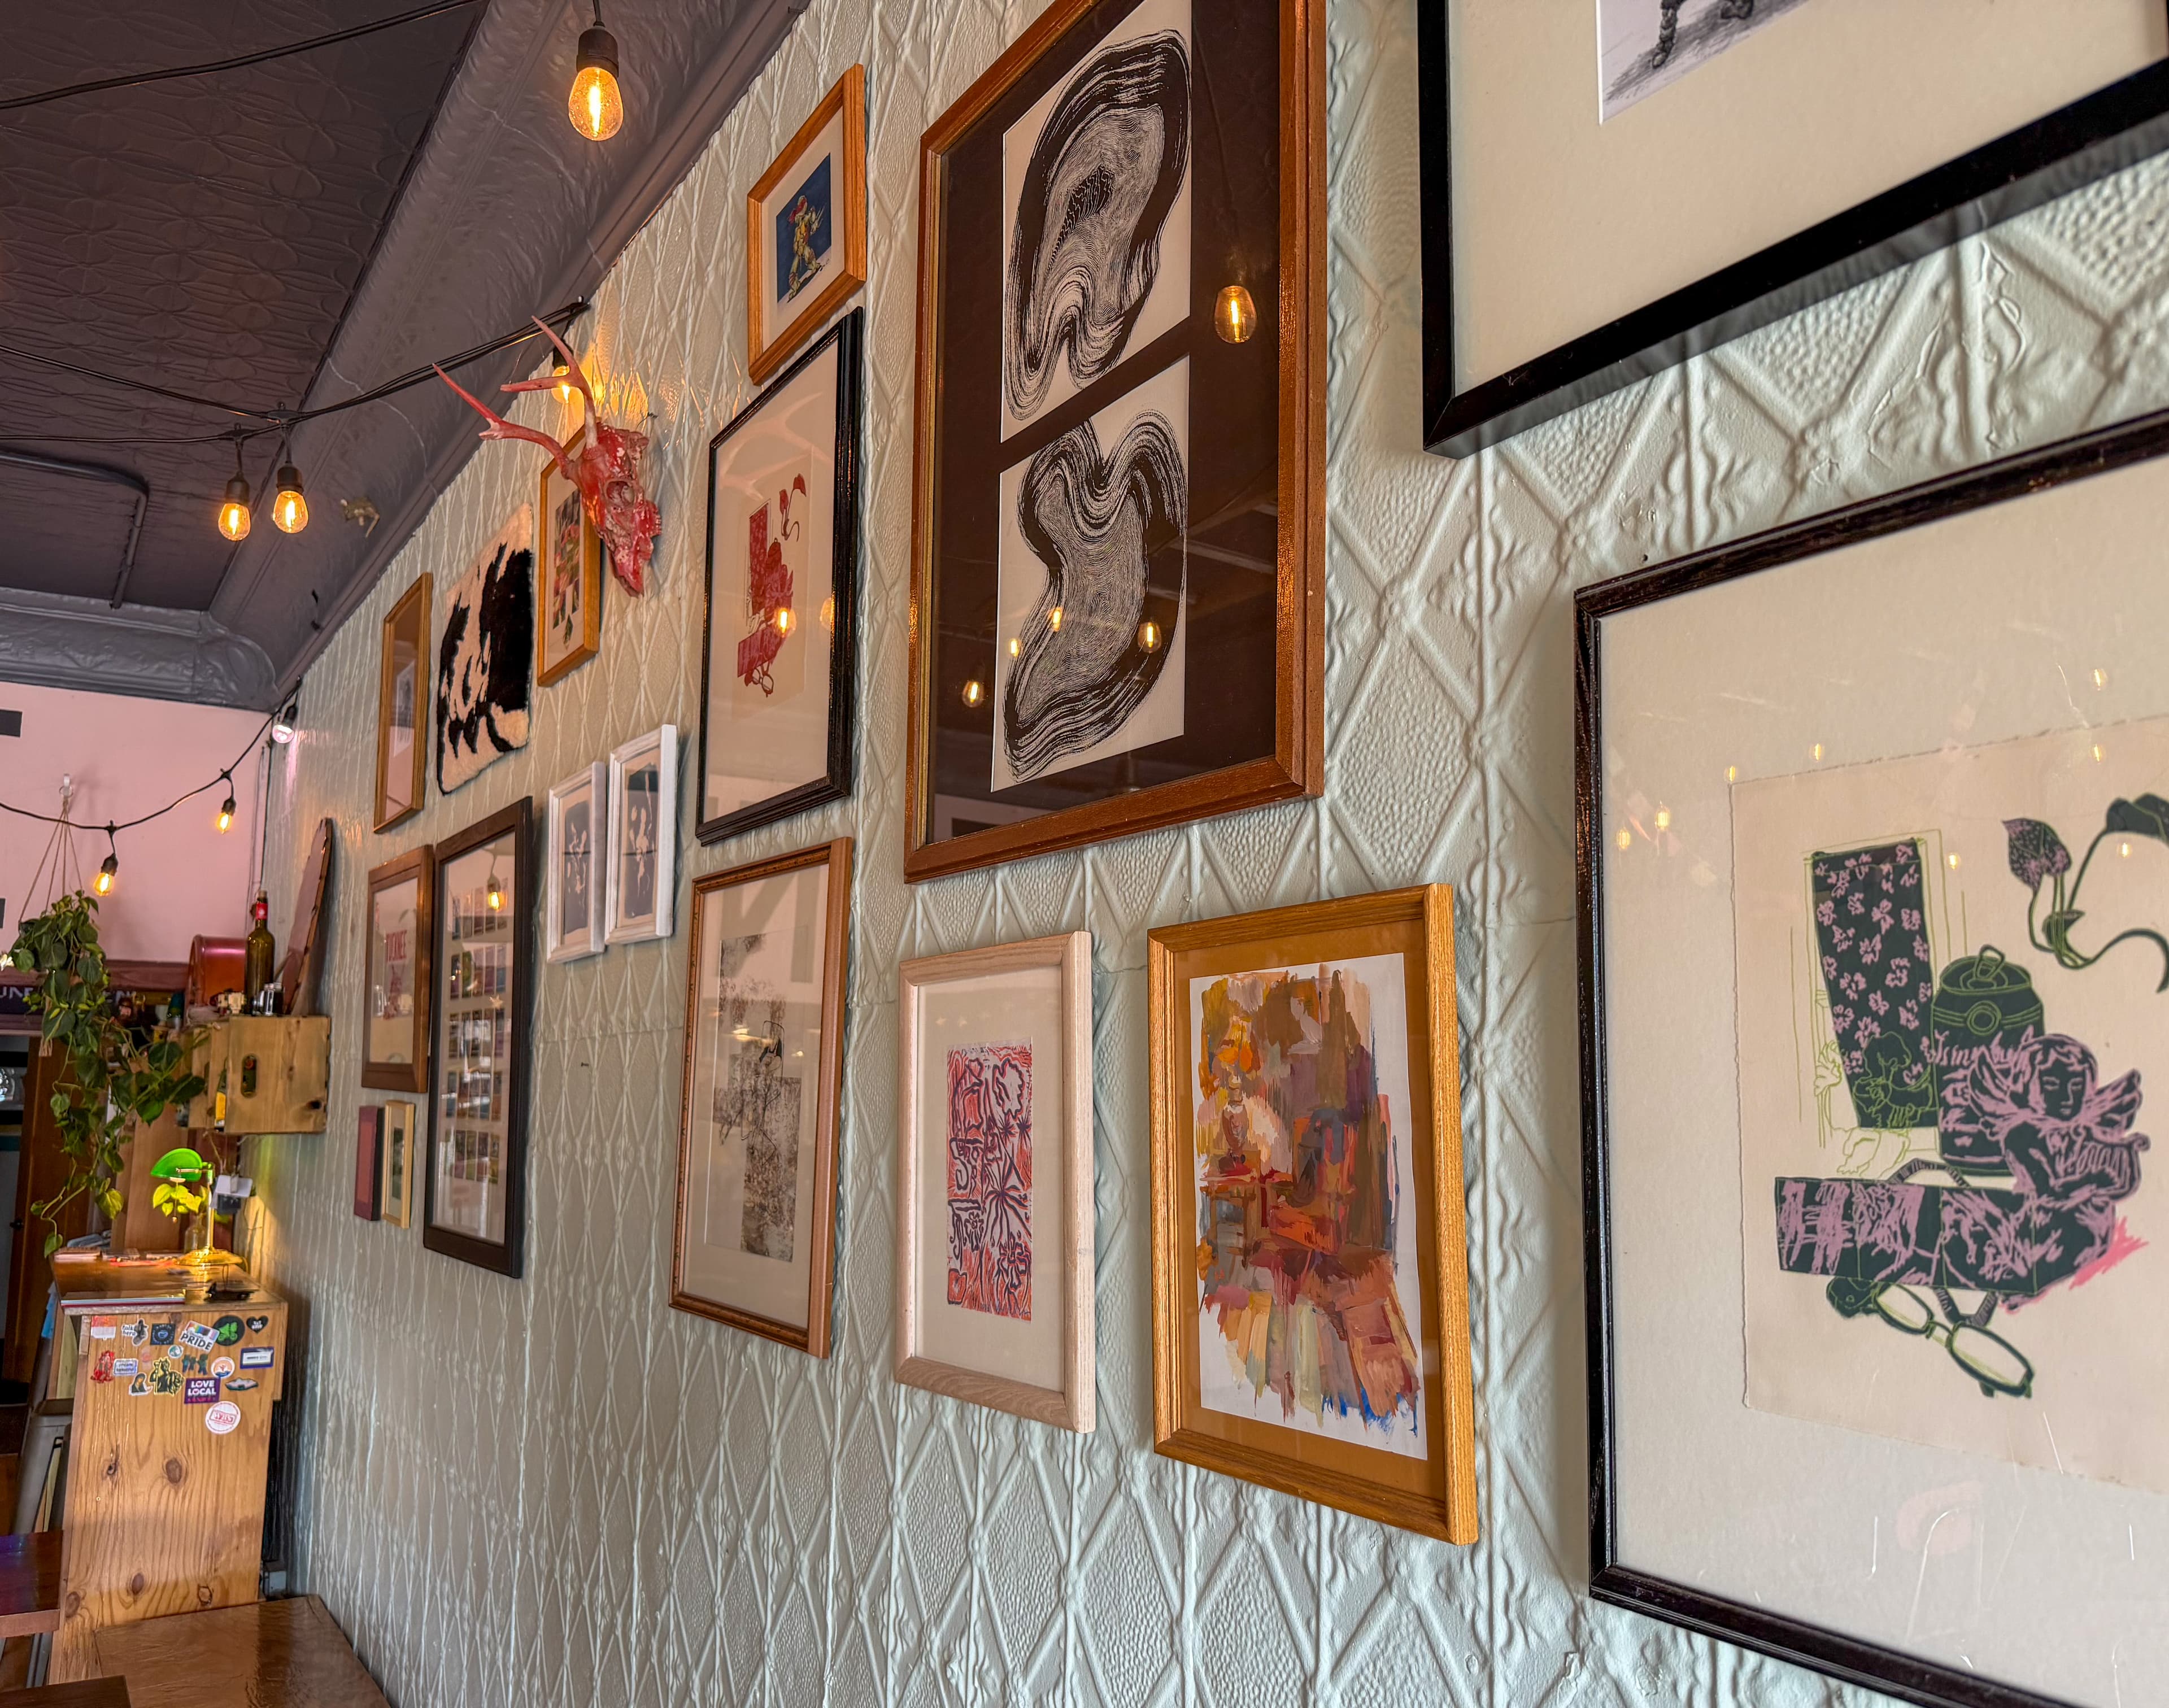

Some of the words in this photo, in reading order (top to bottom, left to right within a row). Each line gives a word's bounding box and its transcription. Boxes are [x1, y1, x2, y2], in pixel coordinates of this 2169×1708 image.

[180, 1333, 213, 1350] PRIDE
[191, 1380, 215, 1388] LOVE
[188, 1388, 216, 1396] LOCAL
